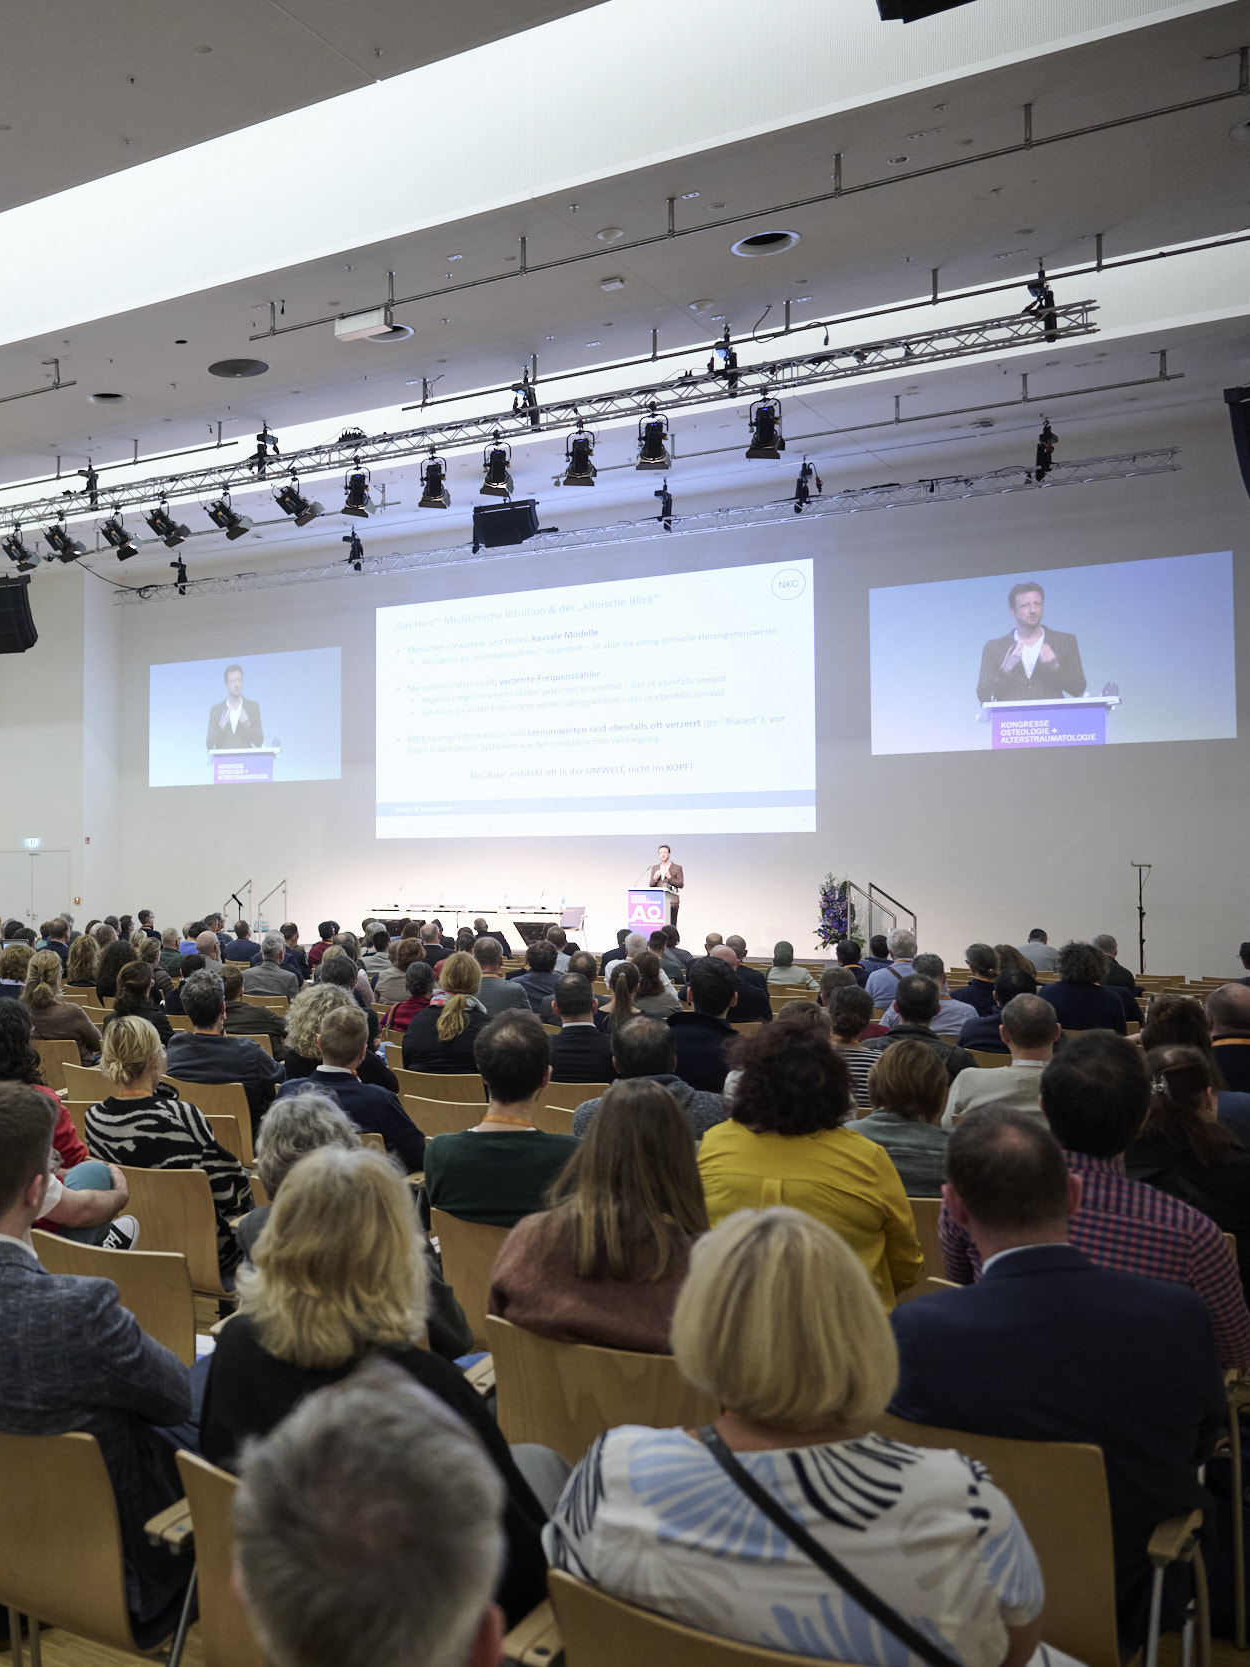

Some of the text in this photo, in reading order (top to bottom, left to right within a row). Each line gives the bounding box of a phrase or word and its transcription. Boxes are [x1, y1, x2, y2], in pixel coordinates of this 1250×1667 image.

[779, 580, 798, 589] NKC
[444, 611, 502, 625] Medizinische
[506, 606, 546, 619] Intuition
[549, 605, 556, 614] &
[559, 603, 575, 613] der
[407, 628, 599, 654] Menschen entwickeln und testen kausale Modelle
[545, 644, 583, 656] dargestellt
[592, 642, 600, 650] ist
[604, 641, 620, 649] aber
[622, 639, 633, 648] die
[637, 637, 659, 648] einzig
[661, 634, 696, 644] sinnvolle
[699, 626, 778, 643] Herangehensweise
[407, 682, 444, 692] Menschen
[447, 681, 461, 689] sind
[499, 677, 535, 685] verzerrte
[537, 670, 600, 684] Frequenzzähler
[488, 690, 514, 699] werden
[543, 686, 578, 697] gewichtet
[593, 682, 622, 693] positive
[631, 681, 644, 689] das
[647, 680, 656, 688] ist
[658, 677, 694, 687] ebenfalls
[696, 675, 726, 684] sinnvoll
[491, 702, 534, 714] Erfahrungen
[536, 700, 563, 709] werden
[655, 691, 691, 701] ebenfalls
[693, 689, 725, 698] sinnvoll
[511, 729, 525, 737] und
[527, 725, 586, 736] Lernumwelten
[589, 724, 606, 733] sind
[609, 722, 648, 732] ebenfalls
[650, 721, 663, 730] oft
[665, 720, 701, 729] verzerrt
[1000, 728, 1050, 737] OSTEOLOGIE
[1001, 720, 1050, 729] KONGRESSE
[536, 740, 548, 748] der
[551, 737, 609, 747] medizinischen
[612, 734, 661, 746] Versorgung.
[1000, 733, 1097, 744] ALTERSTRAUMATOLOGIE
[470, 771, 481, 779] Ein
[510, 769, 543, 778] entsteht
[545, 768, 557, 776] oft
[560, 768, 567, 776] in
[570, 767, 583, 775] der
[586, 765, 625, 776] UMWELT,
[628, 764, 649, 773] nicht
[653, 764, 663, 772] im
[666, 762, 693, 772] KOPF!
